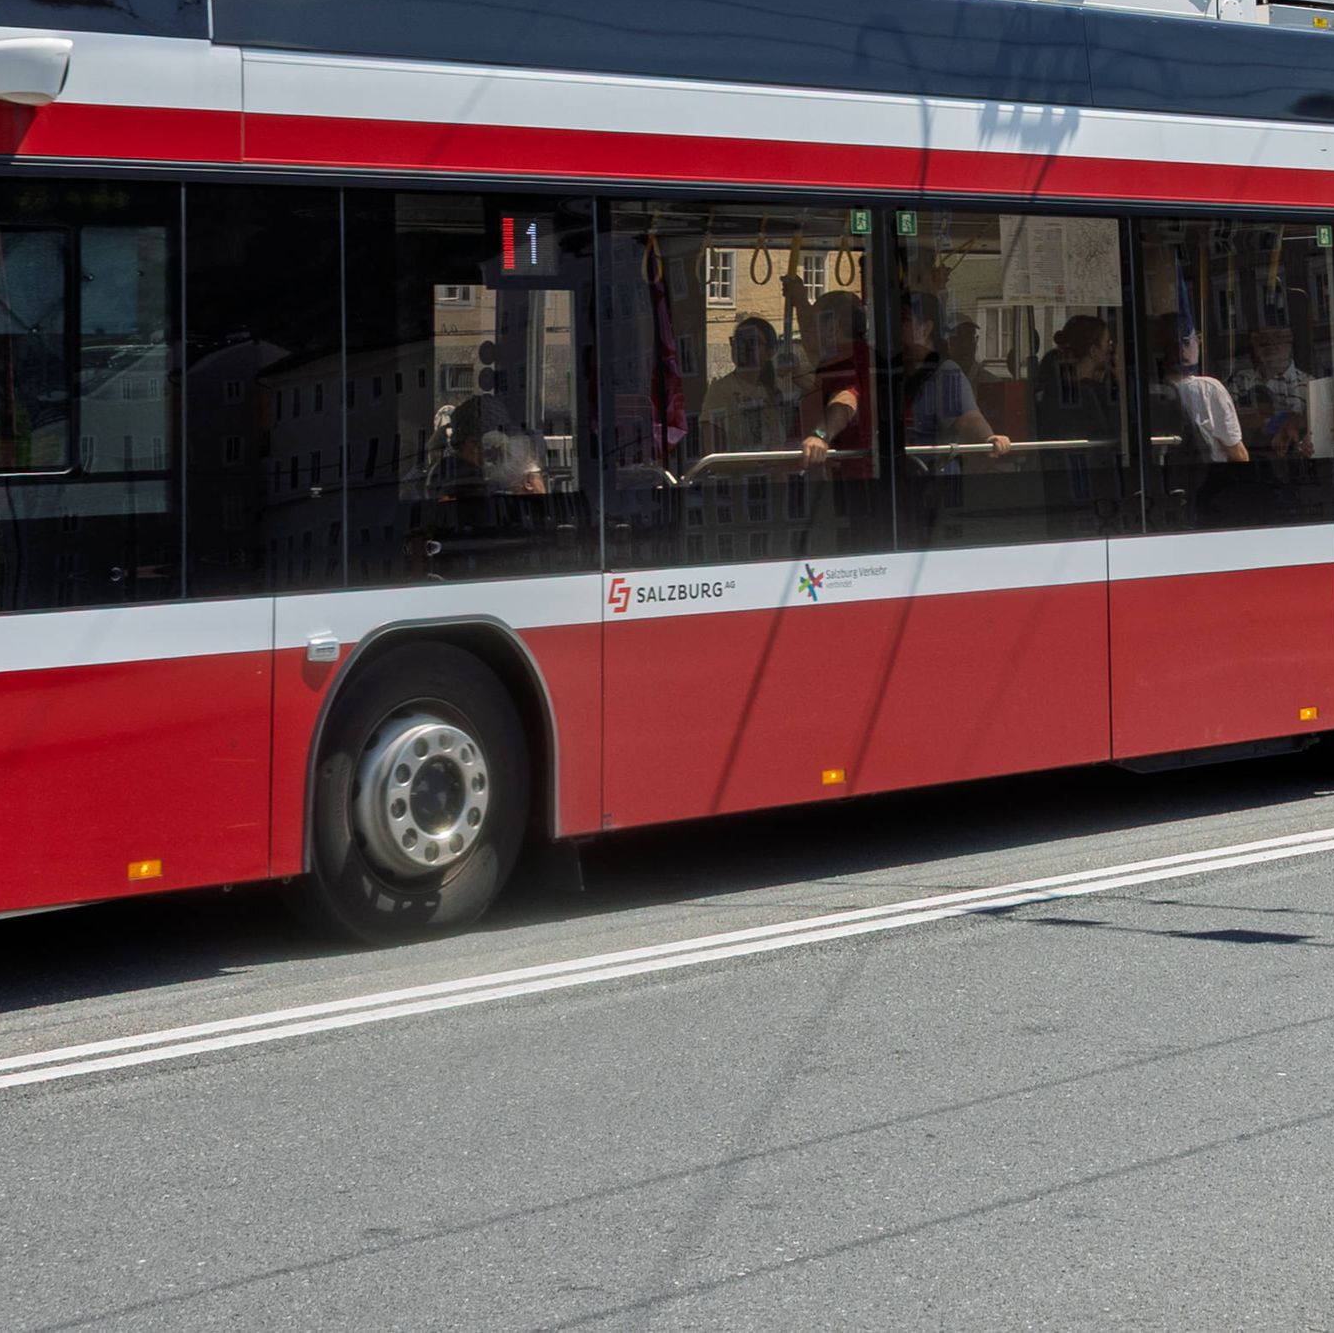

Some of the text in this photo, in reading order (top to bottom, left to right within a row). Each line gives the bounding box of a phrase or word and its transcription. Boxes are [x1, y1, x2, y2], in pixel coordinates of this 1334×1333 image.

[525, 223, 537, 264] 1
[825, 565, 887, 580] Salzburg Verkehr
[636, 580, 736, 603] SALZBURG AG
